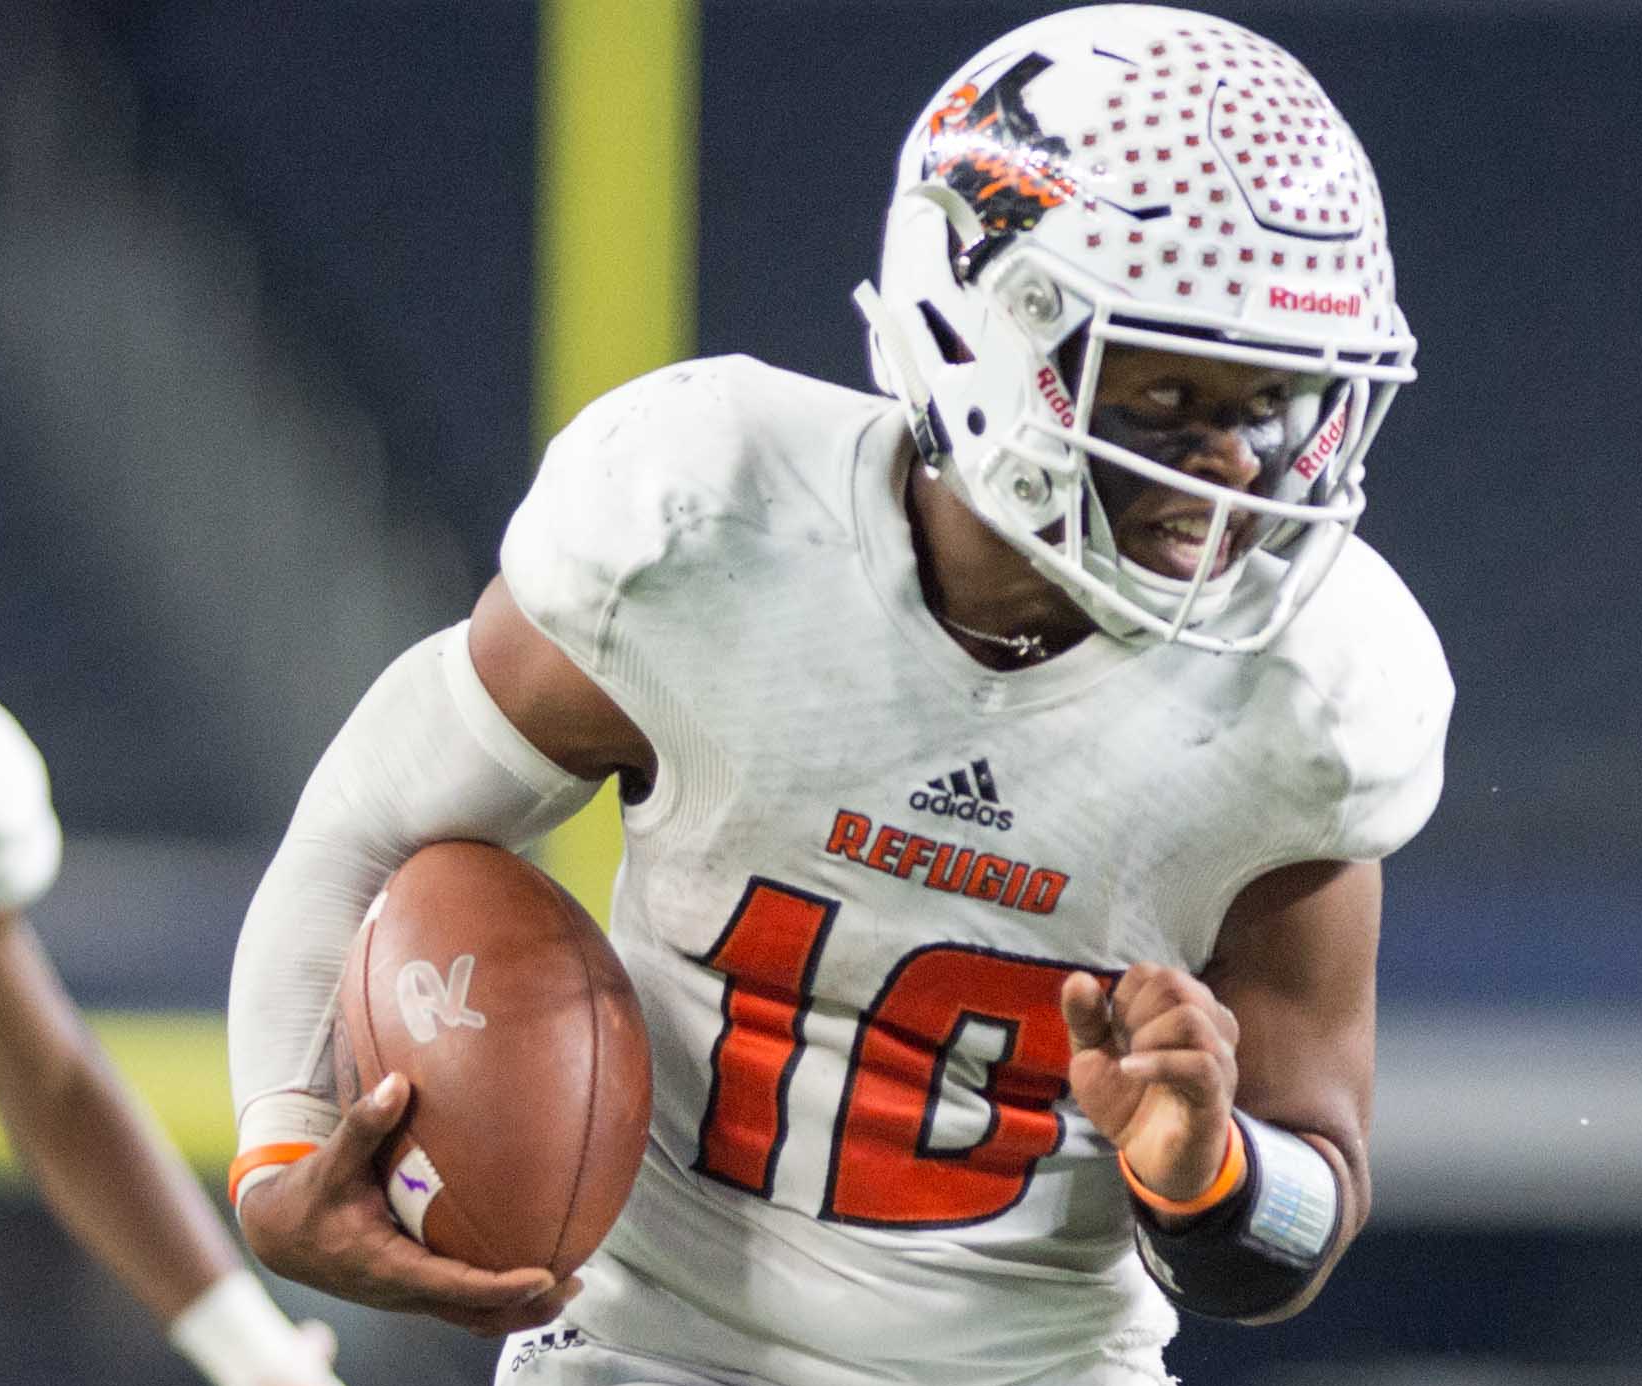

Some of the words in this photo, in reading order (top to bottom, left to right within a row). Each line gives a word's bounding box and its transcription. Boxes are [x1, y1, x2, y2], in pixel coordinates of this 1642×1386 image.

[1268, 285, 1361, 318] Riddell
[908, 787, 1015, 832] adidas
[826, 809, 1071, 916] REFUGIO
[690, 874, 1123, 1230] 10
